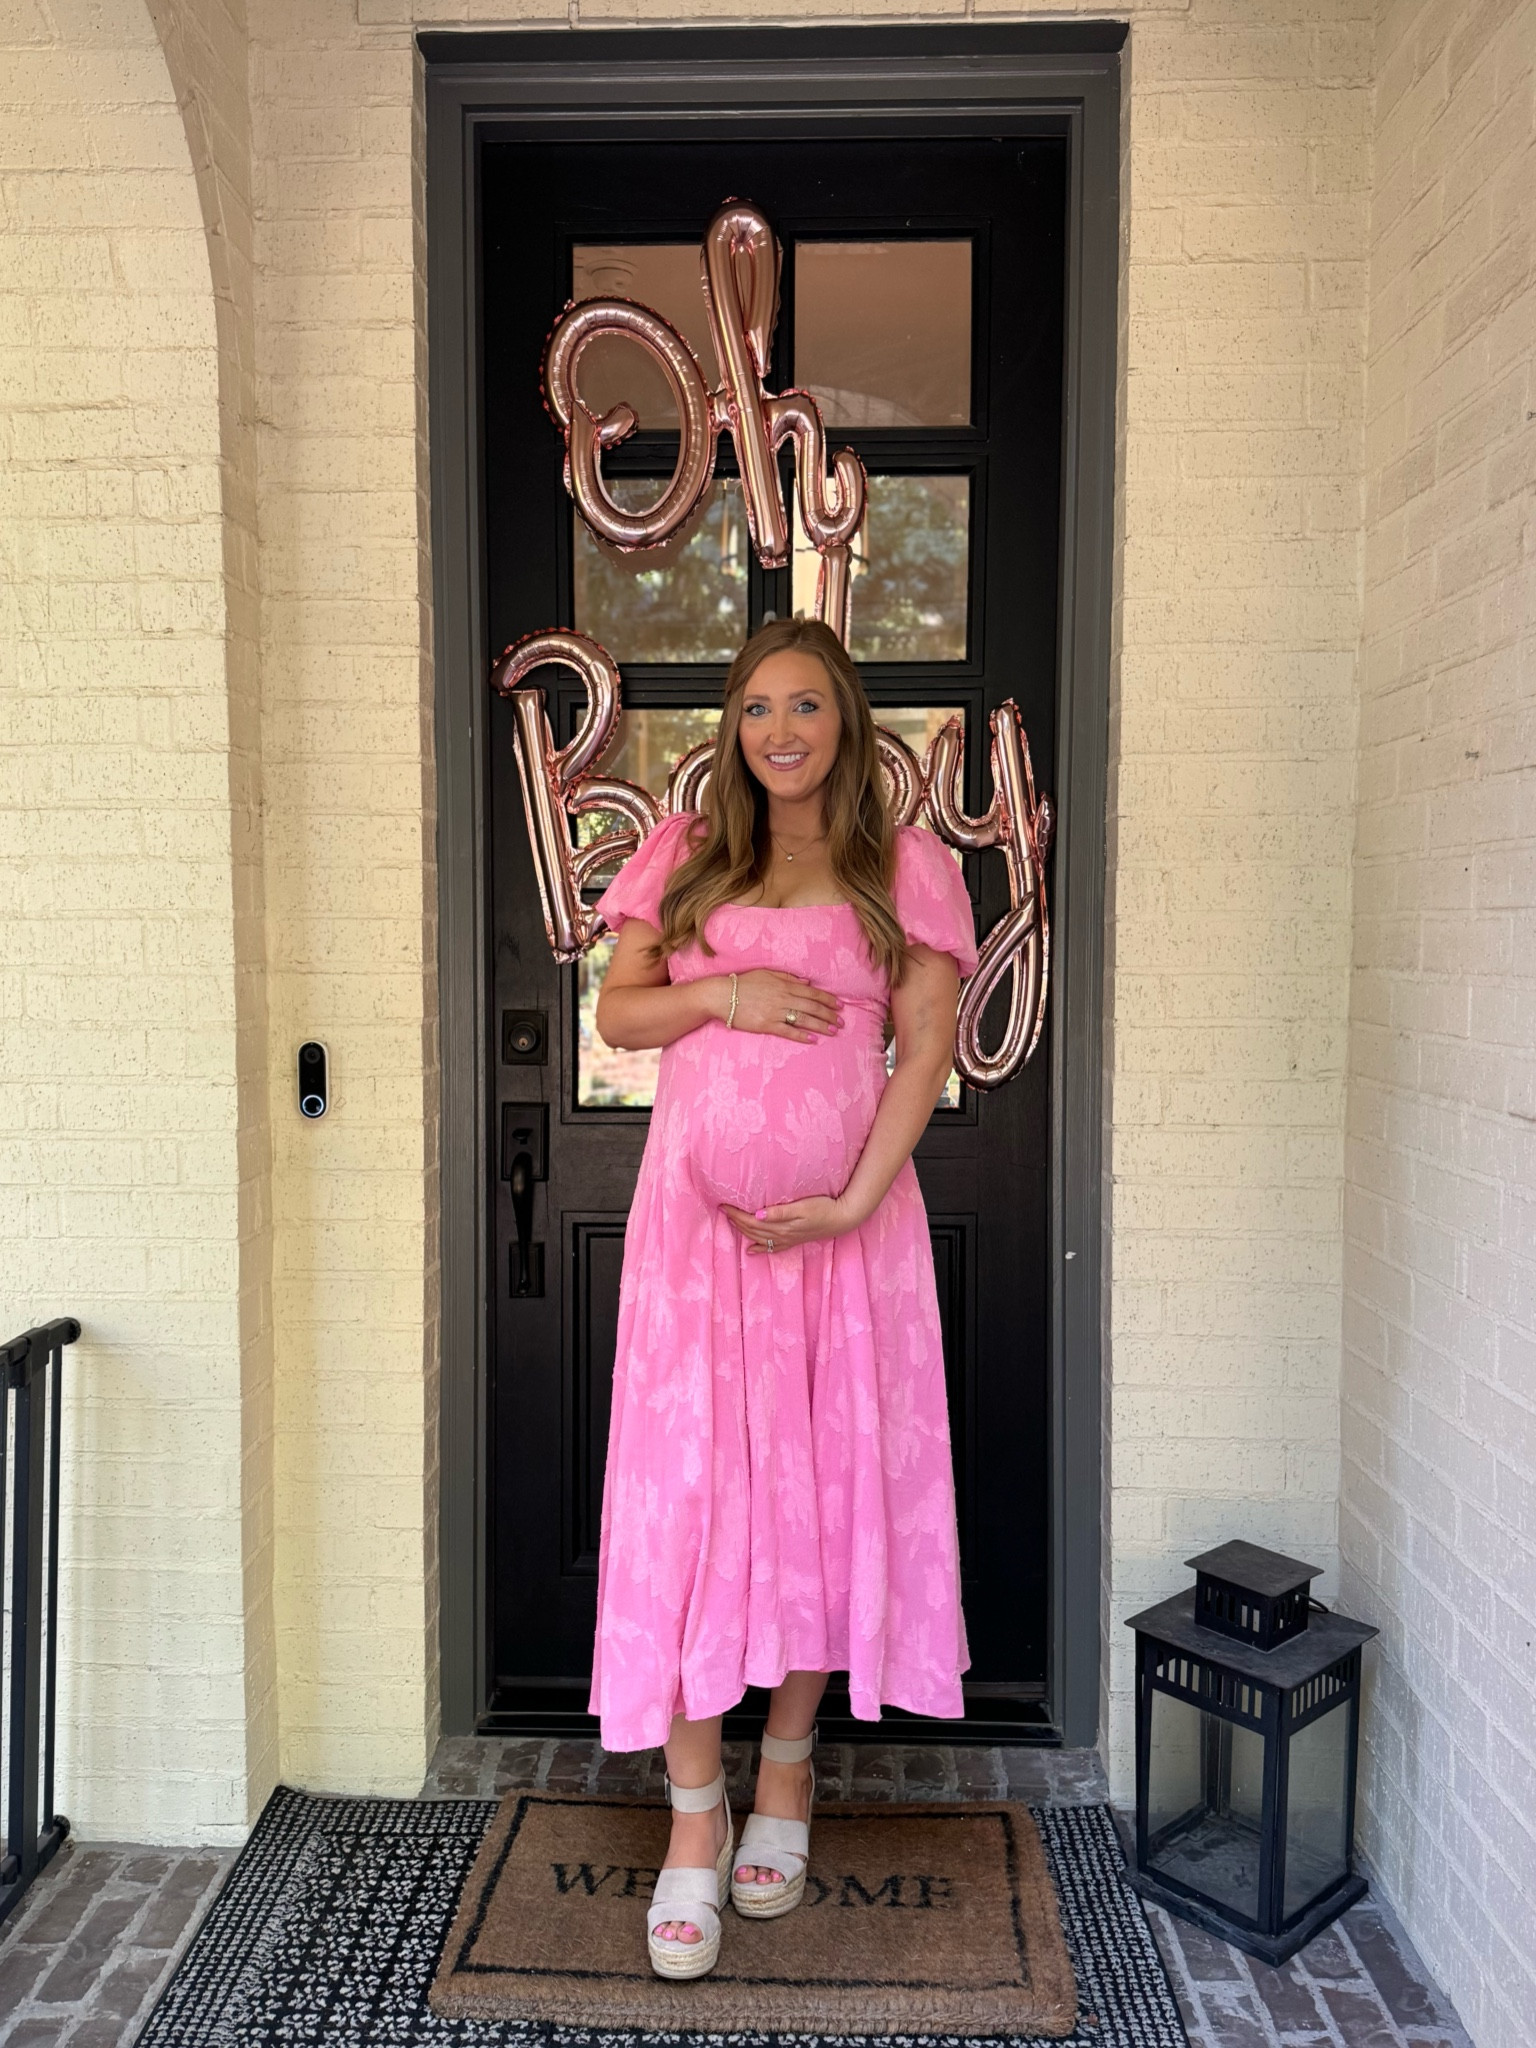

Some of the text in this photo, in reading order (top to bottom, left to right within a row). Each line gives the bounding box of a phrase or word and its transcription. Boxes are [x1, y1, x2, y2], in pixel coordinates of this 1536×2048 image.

[540, 197, 868, 569] Oh
[491, 545, 1054, 1092] By
[550, 1862, 955, 1907] WEOME
